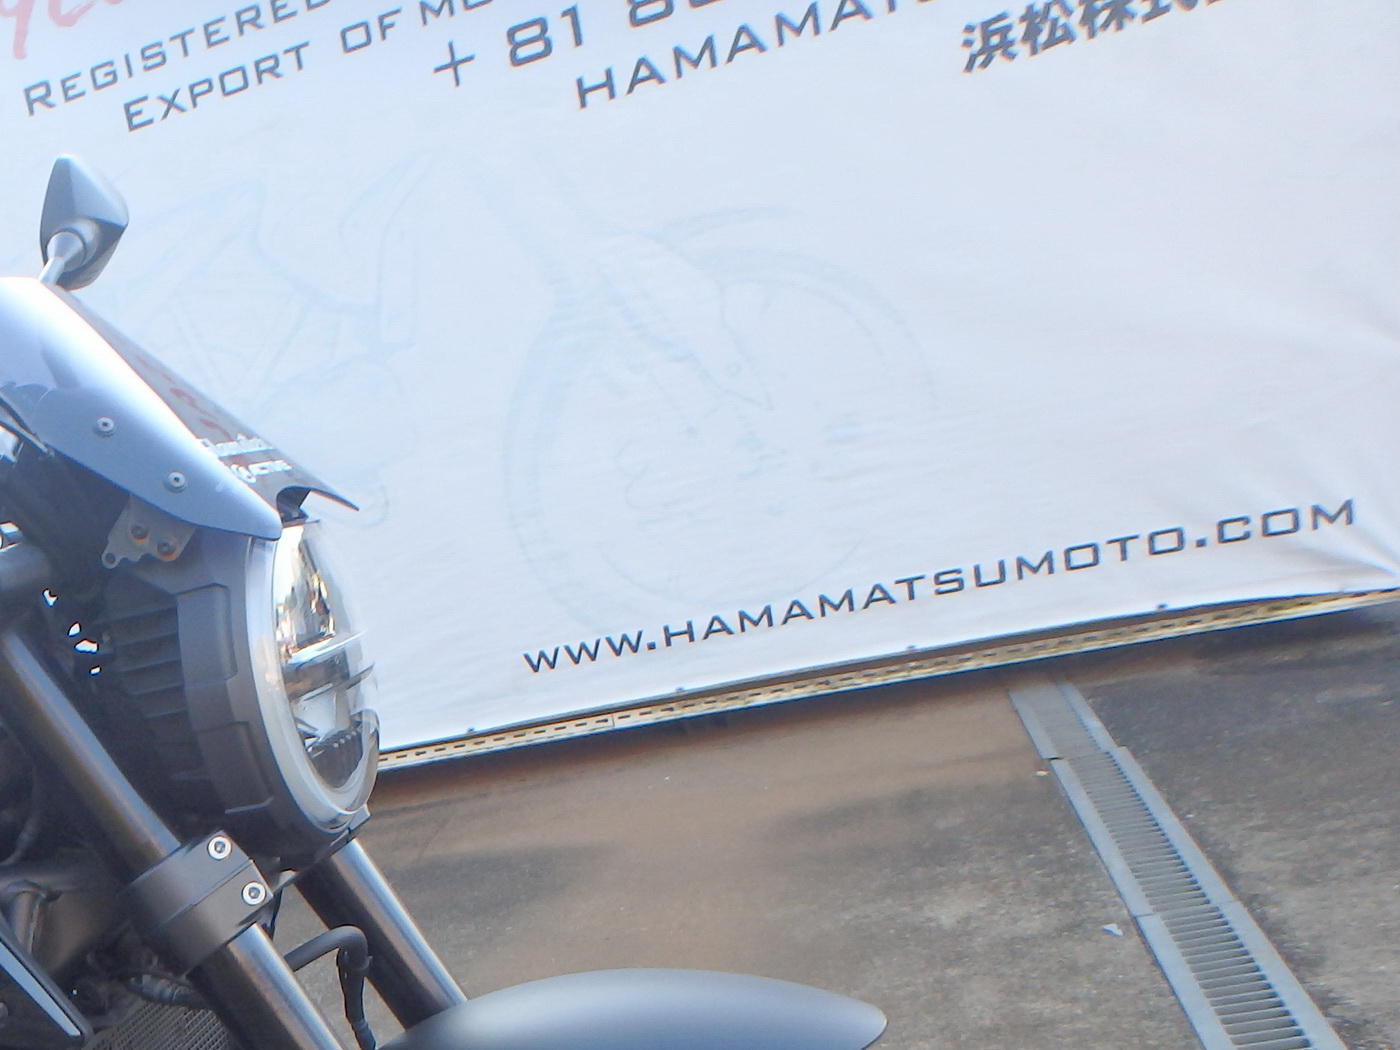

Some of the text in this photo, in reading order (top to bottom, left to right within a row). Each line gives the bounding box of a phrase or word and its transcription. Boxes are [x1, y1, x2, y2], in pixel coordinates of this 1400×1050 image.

[122, 41, 311, 132] EXPORT
[340, 7, 402, 55] OF
[505, 5, 584, 67] 81
[629, 0, 722, 28] 8
[575, 0, 936, 110] HAMAMA
[522, 499, 1354, 674] WWW.HAMAMATSUMOTO.COM
